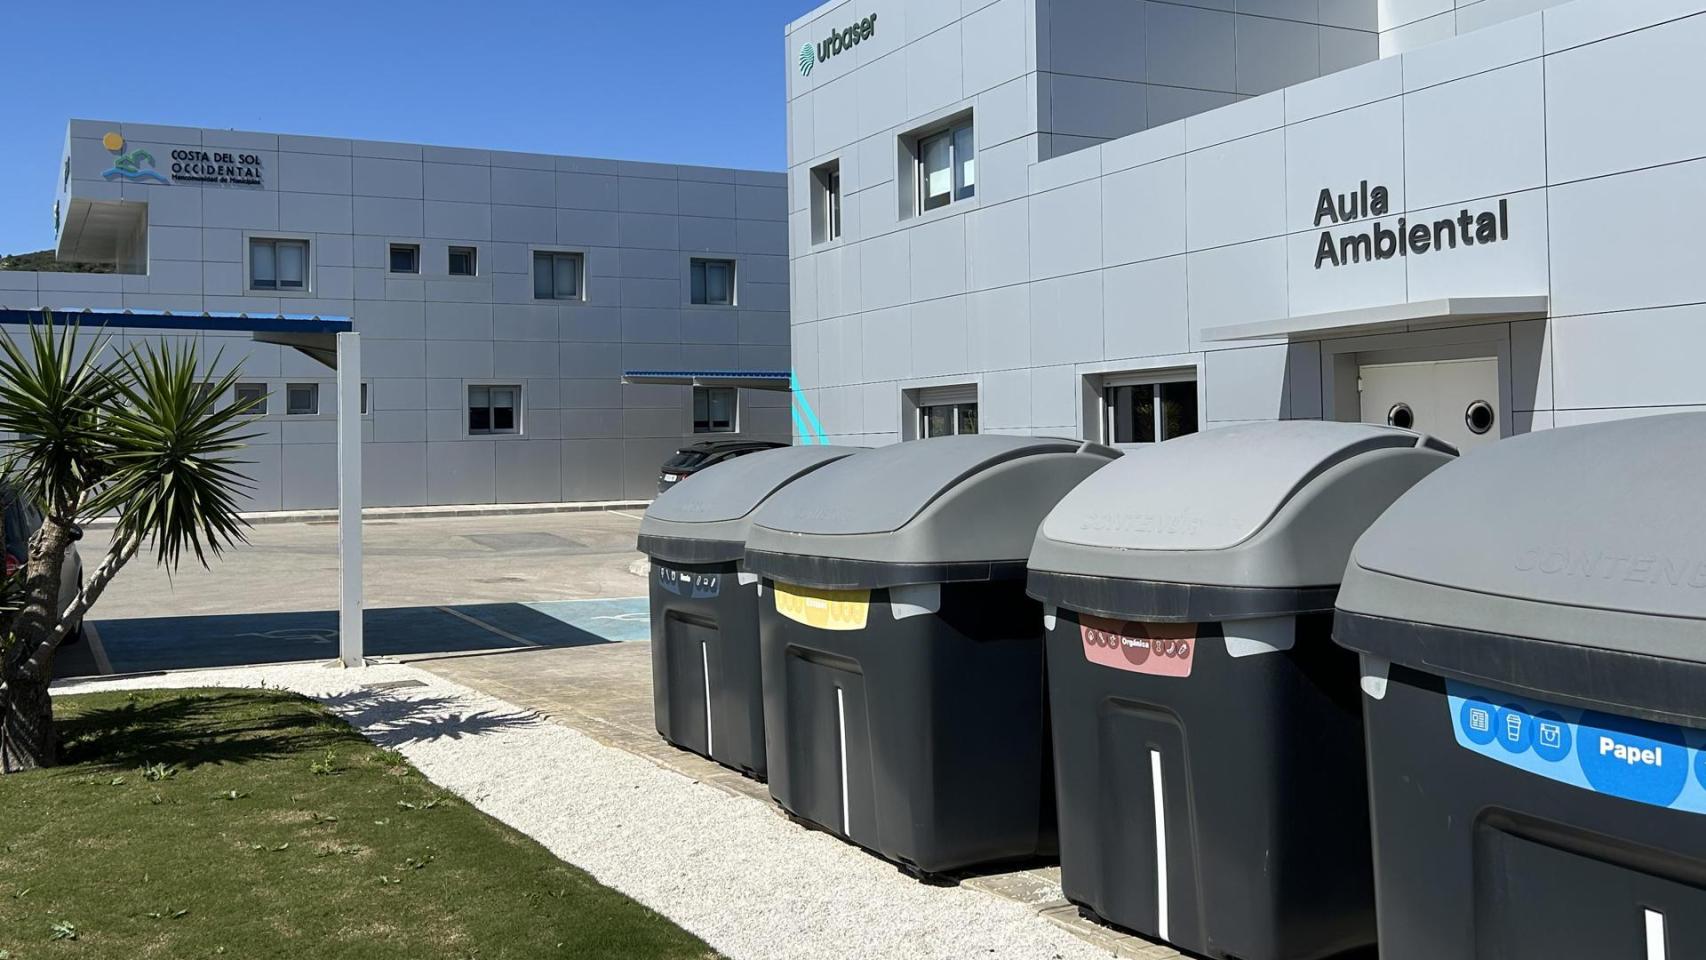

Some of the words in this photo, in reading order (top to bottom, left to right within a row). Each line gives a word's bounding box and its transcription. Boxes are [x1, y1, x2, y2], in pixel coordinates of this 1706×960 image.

[817, 12, 877, 63] urbaser
[171, 149, 209, 161] COSTA
[214, 152, 234, 164] DEL
[238, 154, 261, 166] SOL
[171, 163, 261, 178] OCCIDENTAL
[1313, 179, 1389, 227] Aula
[1313, 198, 1509, 270] Ambiental
[1599, 736, 1663, 768] Papel
